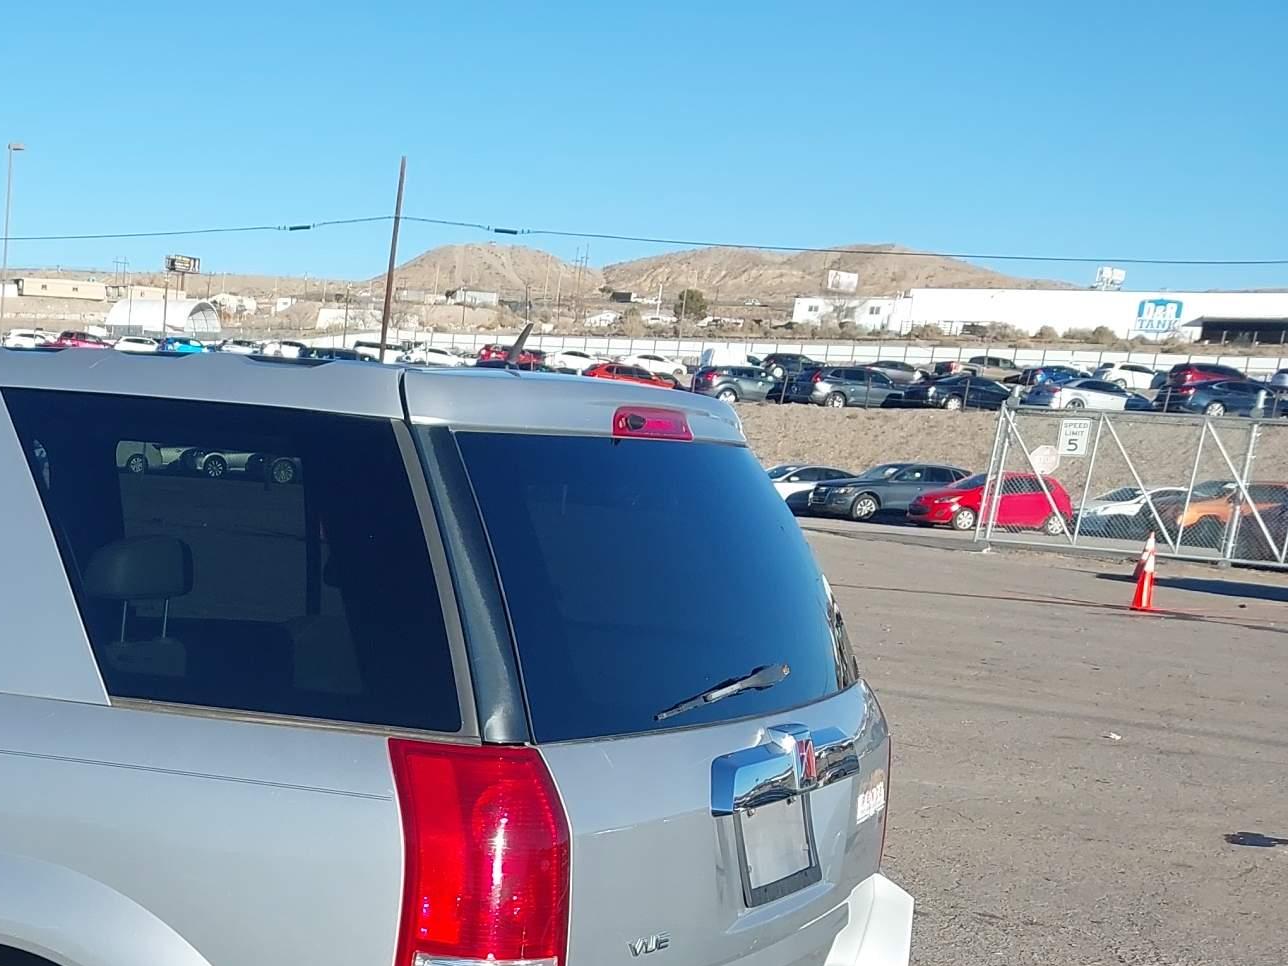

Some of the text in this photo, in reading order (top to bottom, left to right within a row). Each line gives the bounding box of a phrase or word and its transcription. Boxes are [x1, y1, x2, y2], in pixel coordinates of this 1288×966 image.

[1137, 319, 1178, 329] TANK
[1066, 438, 1079, 452] 5
[626, 931, 671, 957] VUE
